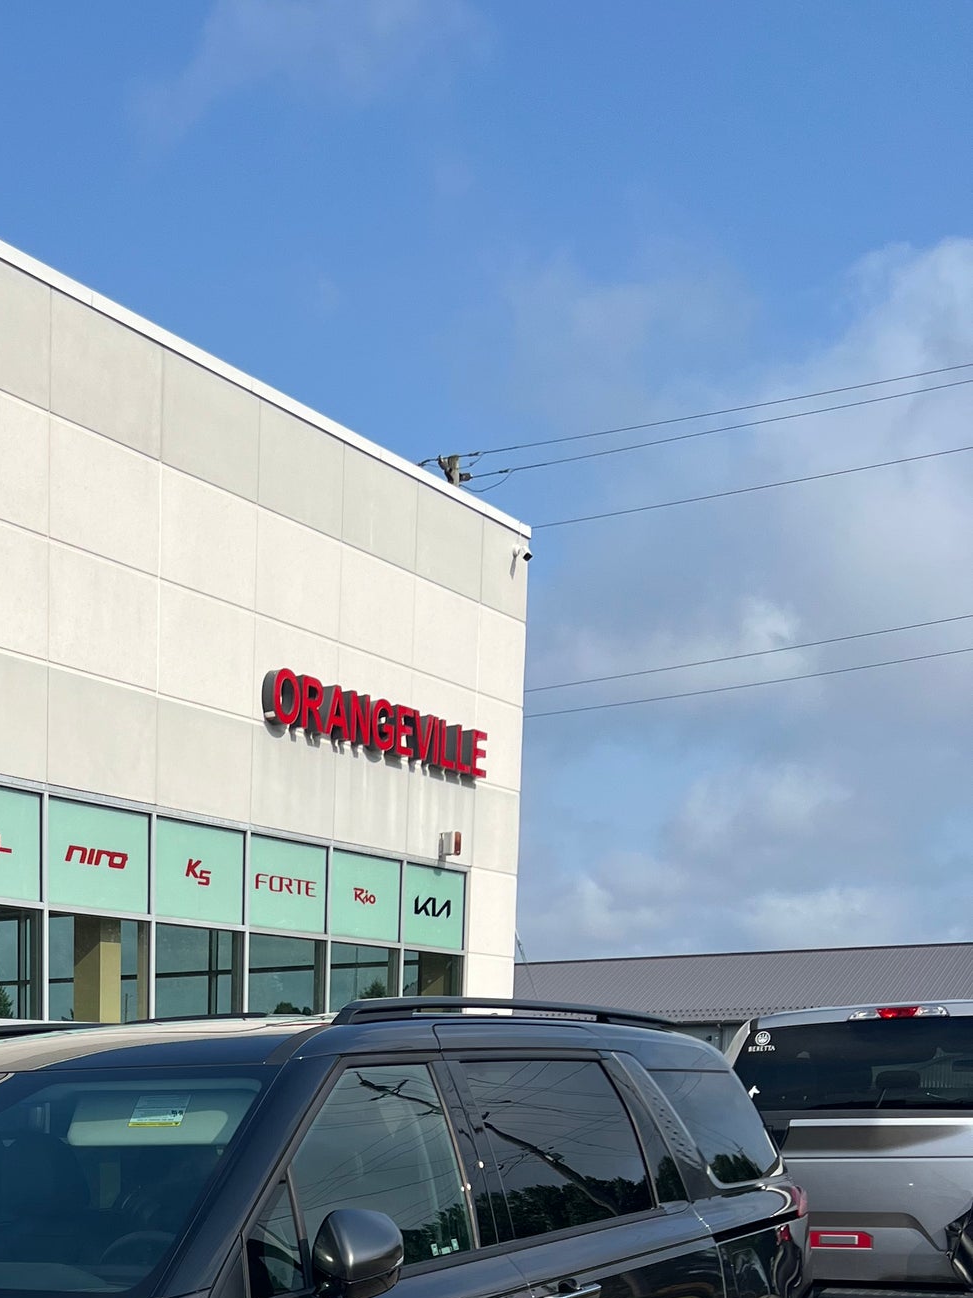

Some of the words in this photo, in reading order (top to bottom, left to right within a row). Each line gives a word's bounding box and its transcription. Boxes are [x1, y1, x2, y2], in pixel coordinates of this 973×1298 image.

[265, 668, 488, 778] ORANGEVILLE
[255, 873, 317, 898] FORTE
[353, 887, 376, 905] Rio
[414, 896, 451, 919] KIA
